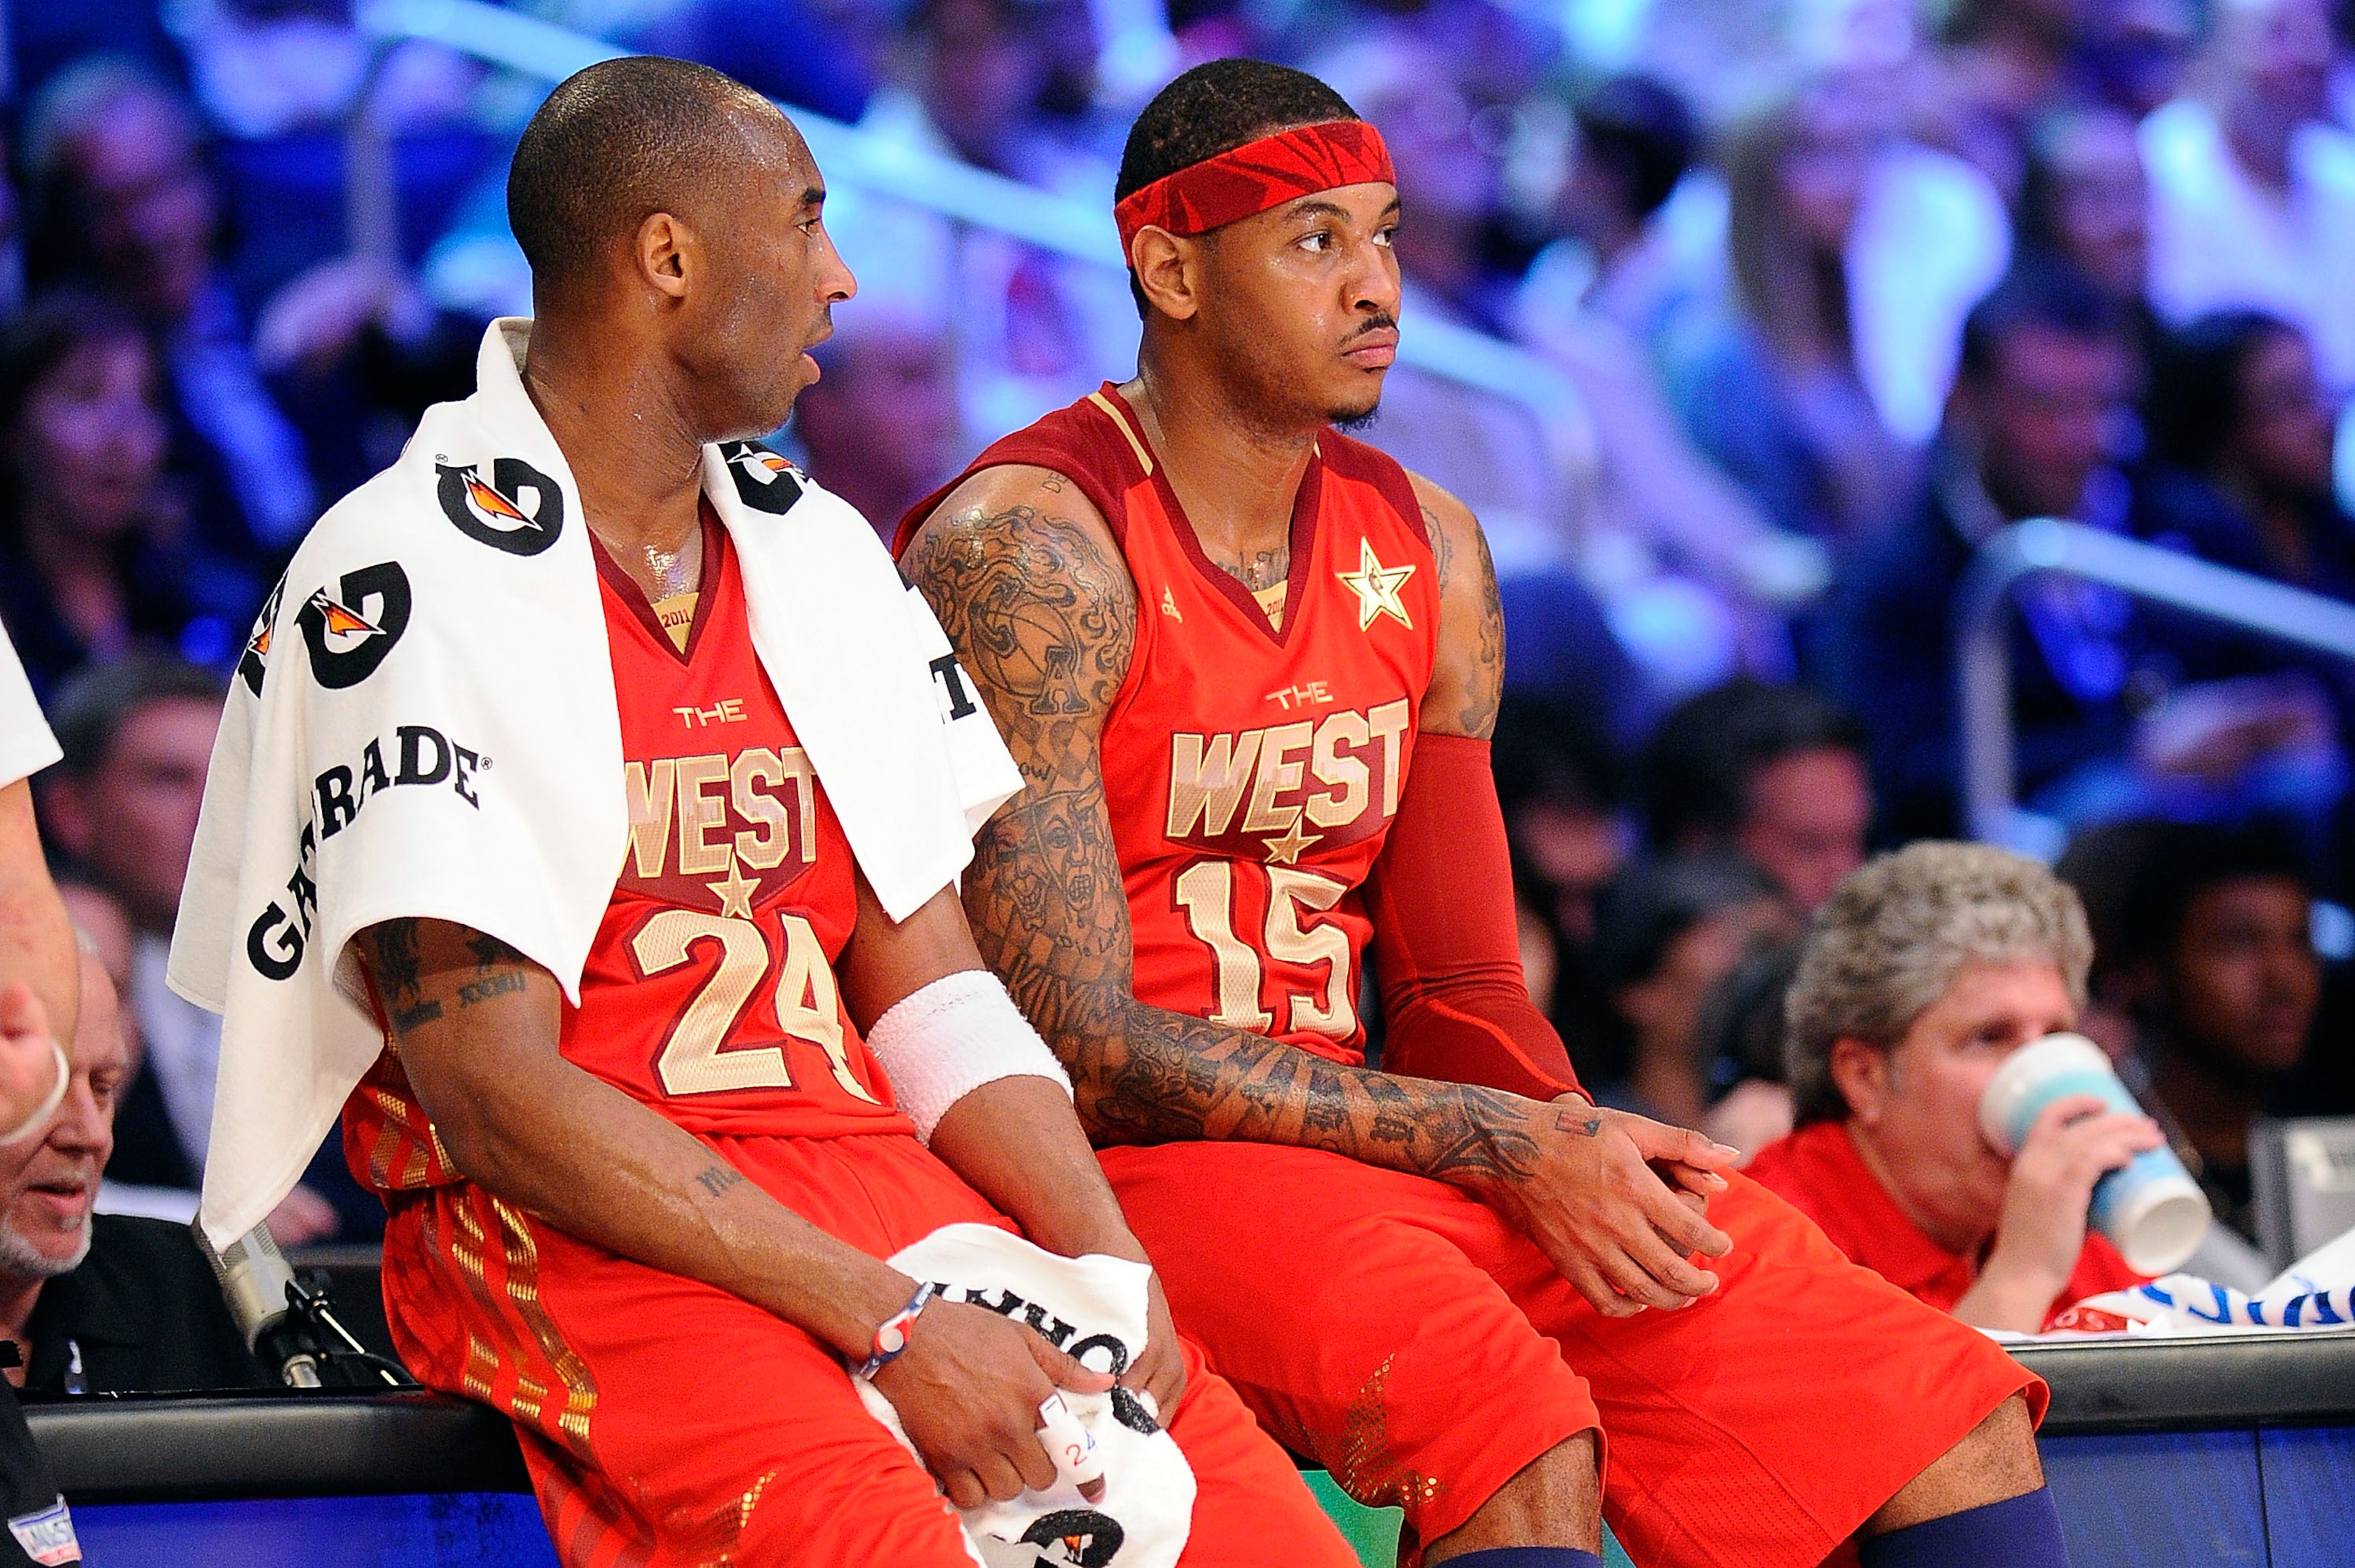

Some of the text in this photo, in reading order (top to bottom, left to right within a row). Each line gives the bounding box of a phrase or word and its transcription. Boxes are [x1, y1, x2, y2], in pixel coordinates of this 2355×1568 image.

[661, 609, 692, 629] 2011
[672, 698, 748, 730] THE
[1265, 681, 1334, 710] THE
[619, 746, 817, 878] WEST
[1165, 697, 1410, 839] WEST
[629, 908, 882, 1106] 24
[1174, 860, 1357, 1041] 15
